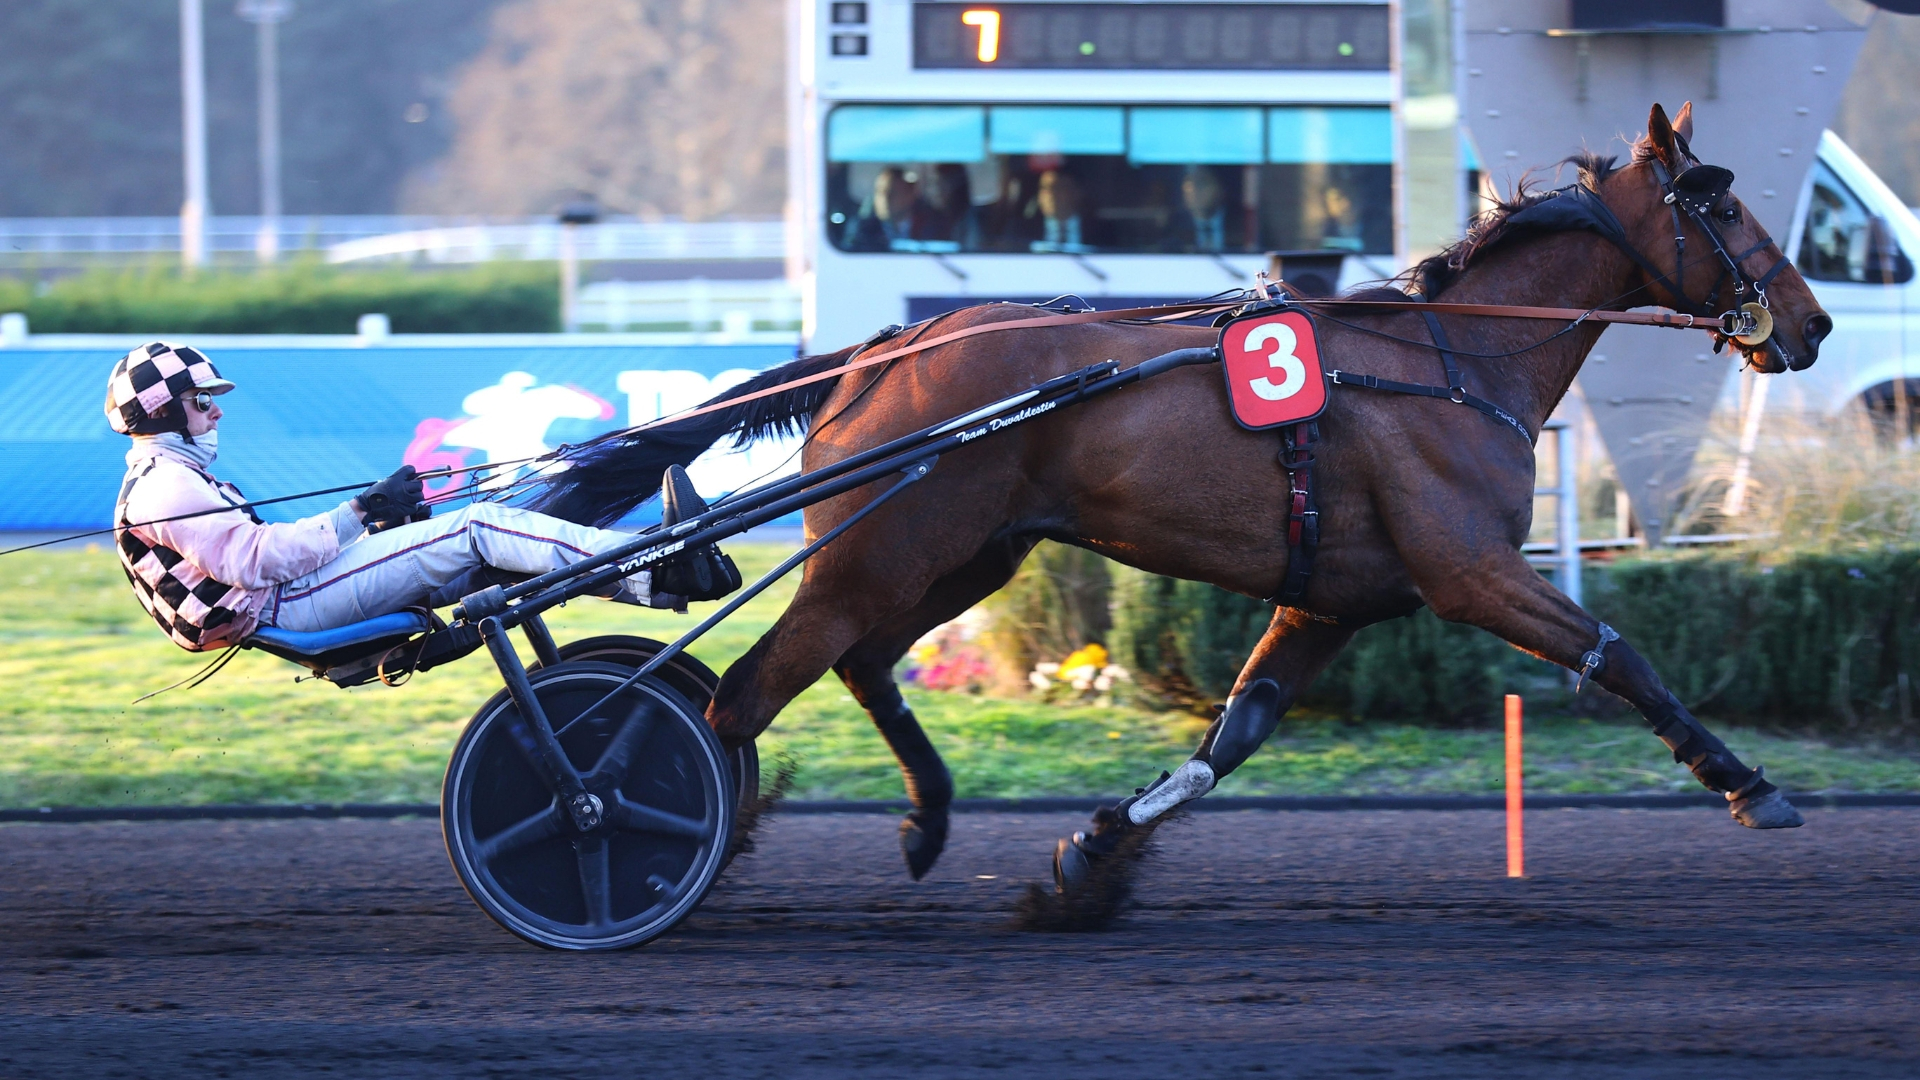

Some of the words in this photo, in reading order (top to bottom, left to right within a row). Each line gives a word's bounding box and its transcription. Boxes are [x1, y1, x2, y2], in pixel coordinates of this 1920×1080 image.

[962, 10, 1000, 62] 7
[1243, 322, 1307, 402] 3
[955, 427, 988, 443] Team
[989, 400, 1057, 431] Duvaldestin
[617, 539, 686, 573] YANKEE
